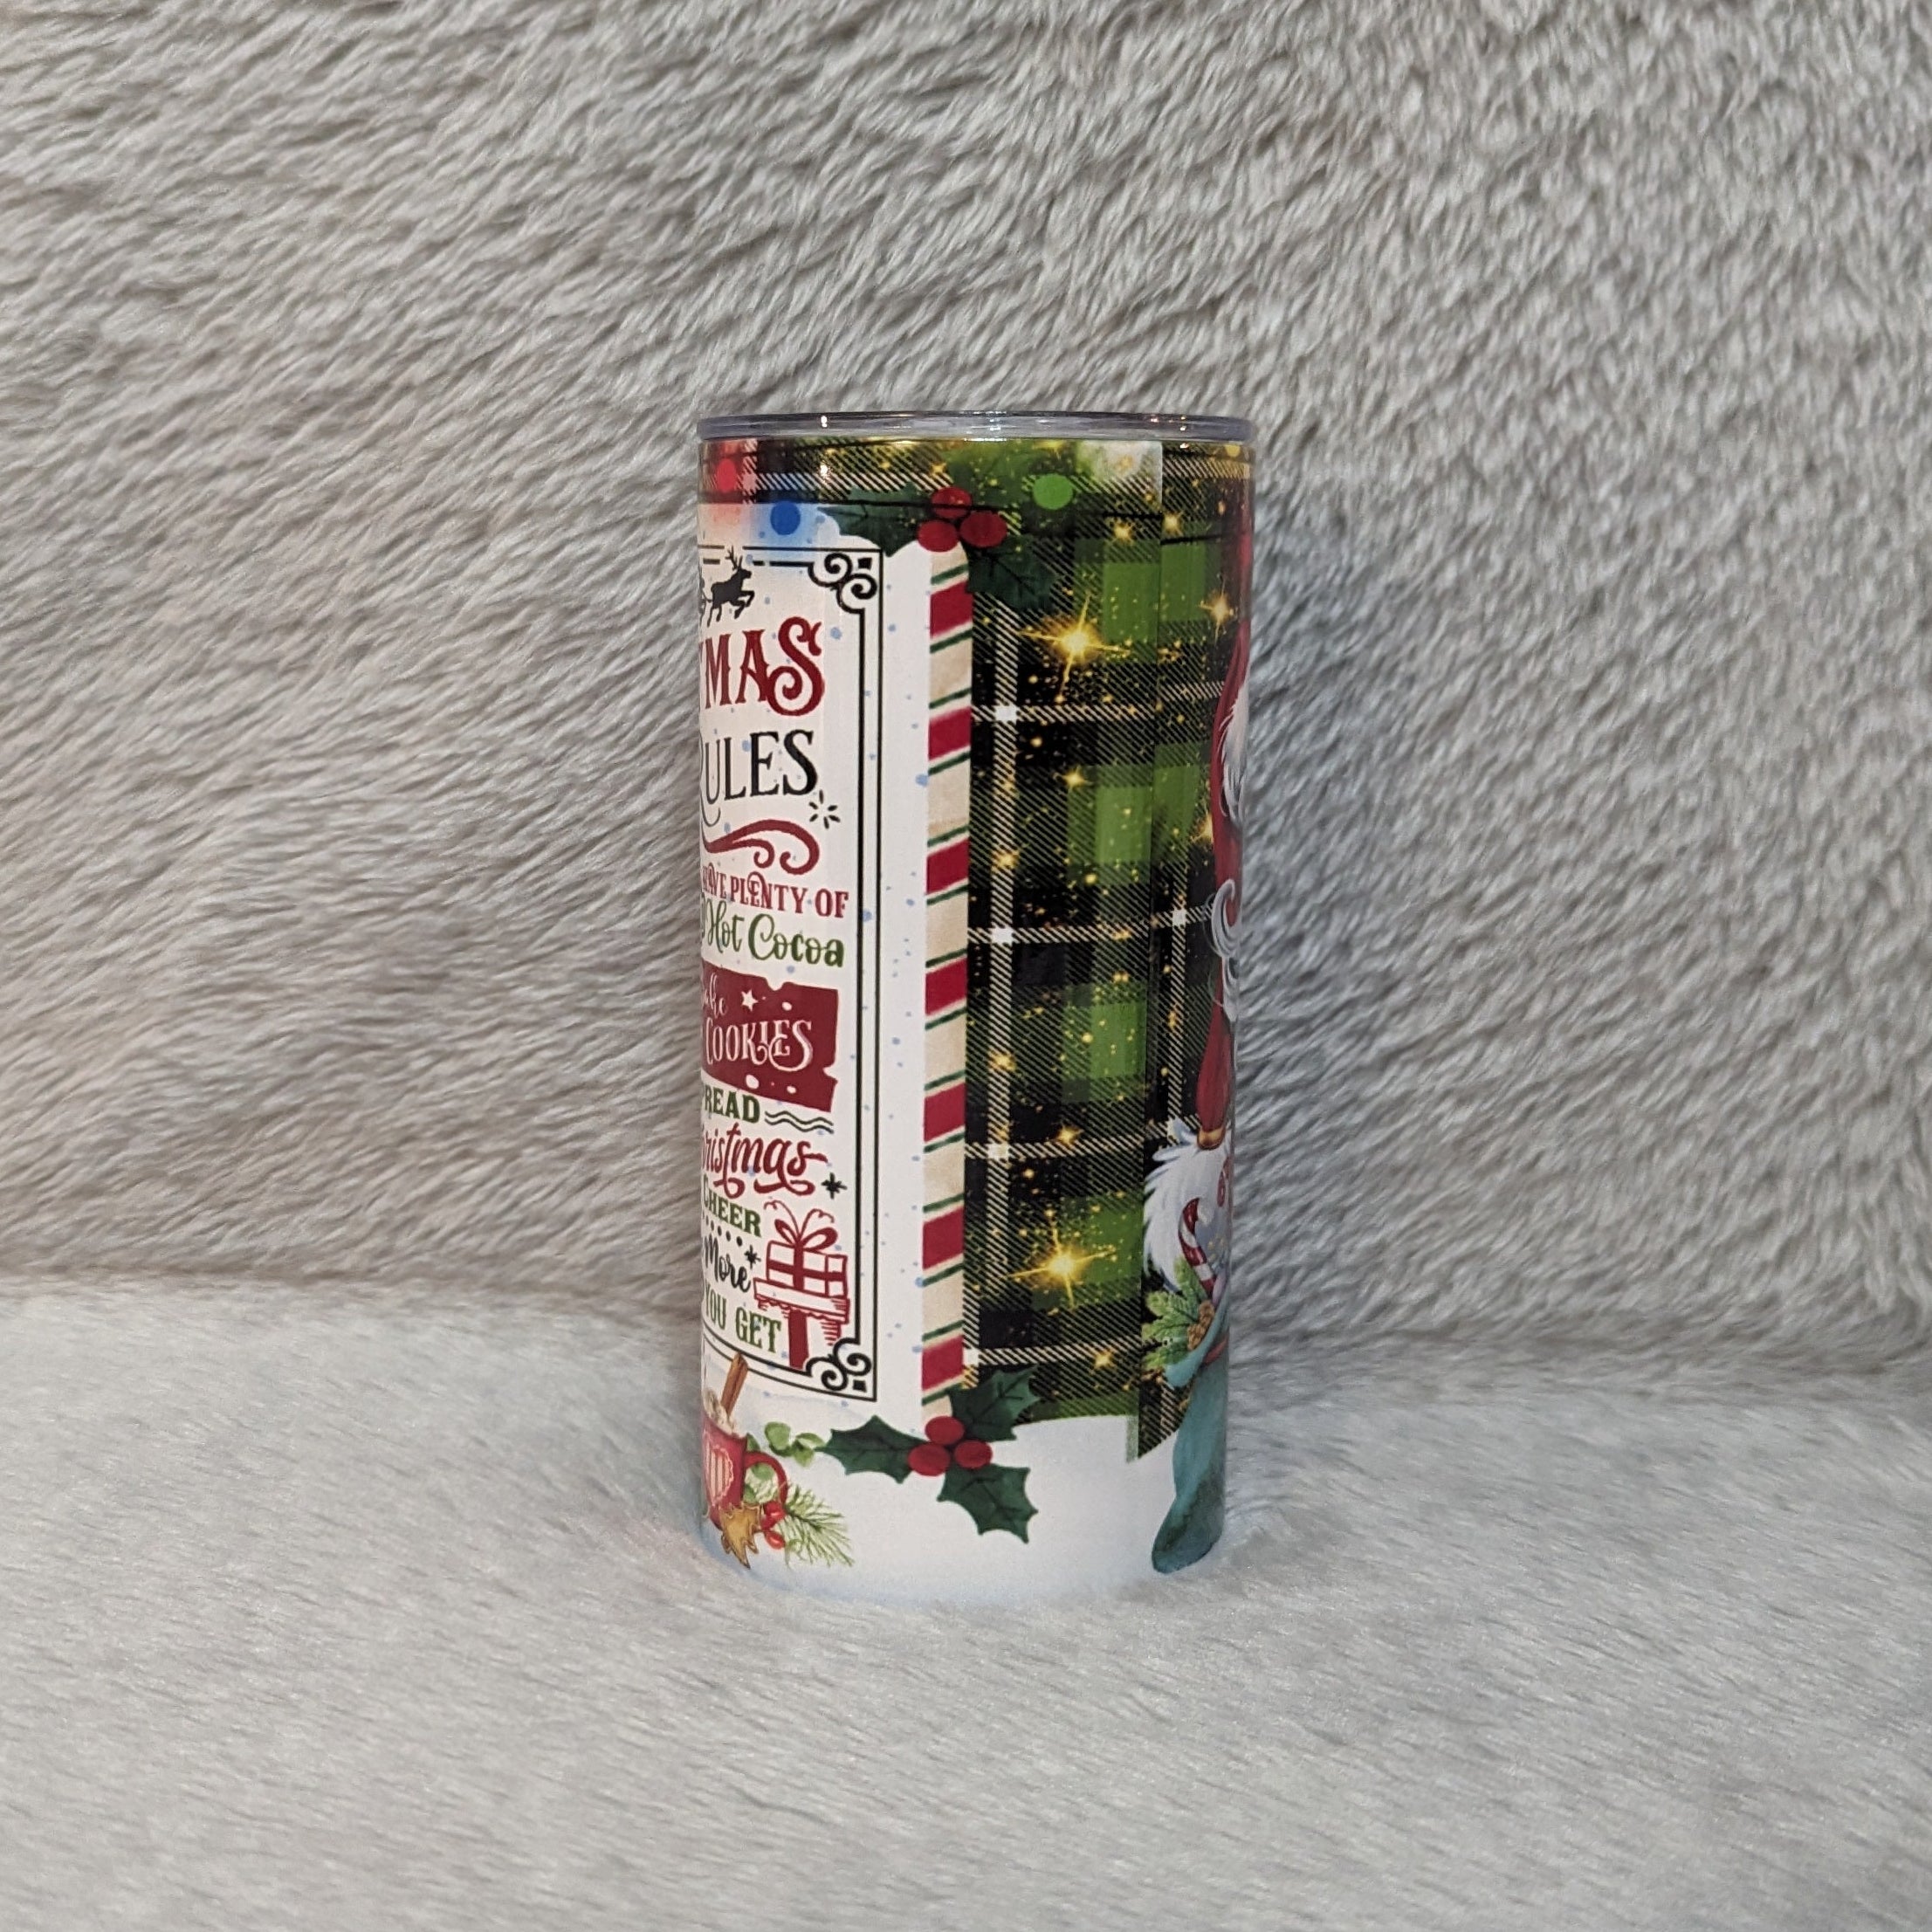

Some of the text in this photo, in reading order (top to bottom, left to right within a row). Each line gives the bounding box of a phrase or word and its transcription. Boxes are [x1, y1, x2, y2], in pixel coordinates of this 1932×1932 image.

[699, 616, 825, 716] MAS
[730, 871, 808, 913] PLENTY
[815, 888, 849, 918] OF
[706, 899, 844, 967] Hot Cocoa
[705, 1019, 813, 1072] COOKIES
[705, 1084, 760, 1124] READ
[702, 1122, 828, 1200] ristmas
[703, 1174, 761, 1238] CHEER
[704, 1233, 751, 1293] More
[705, 1279, 781, 1353] YOU GET
